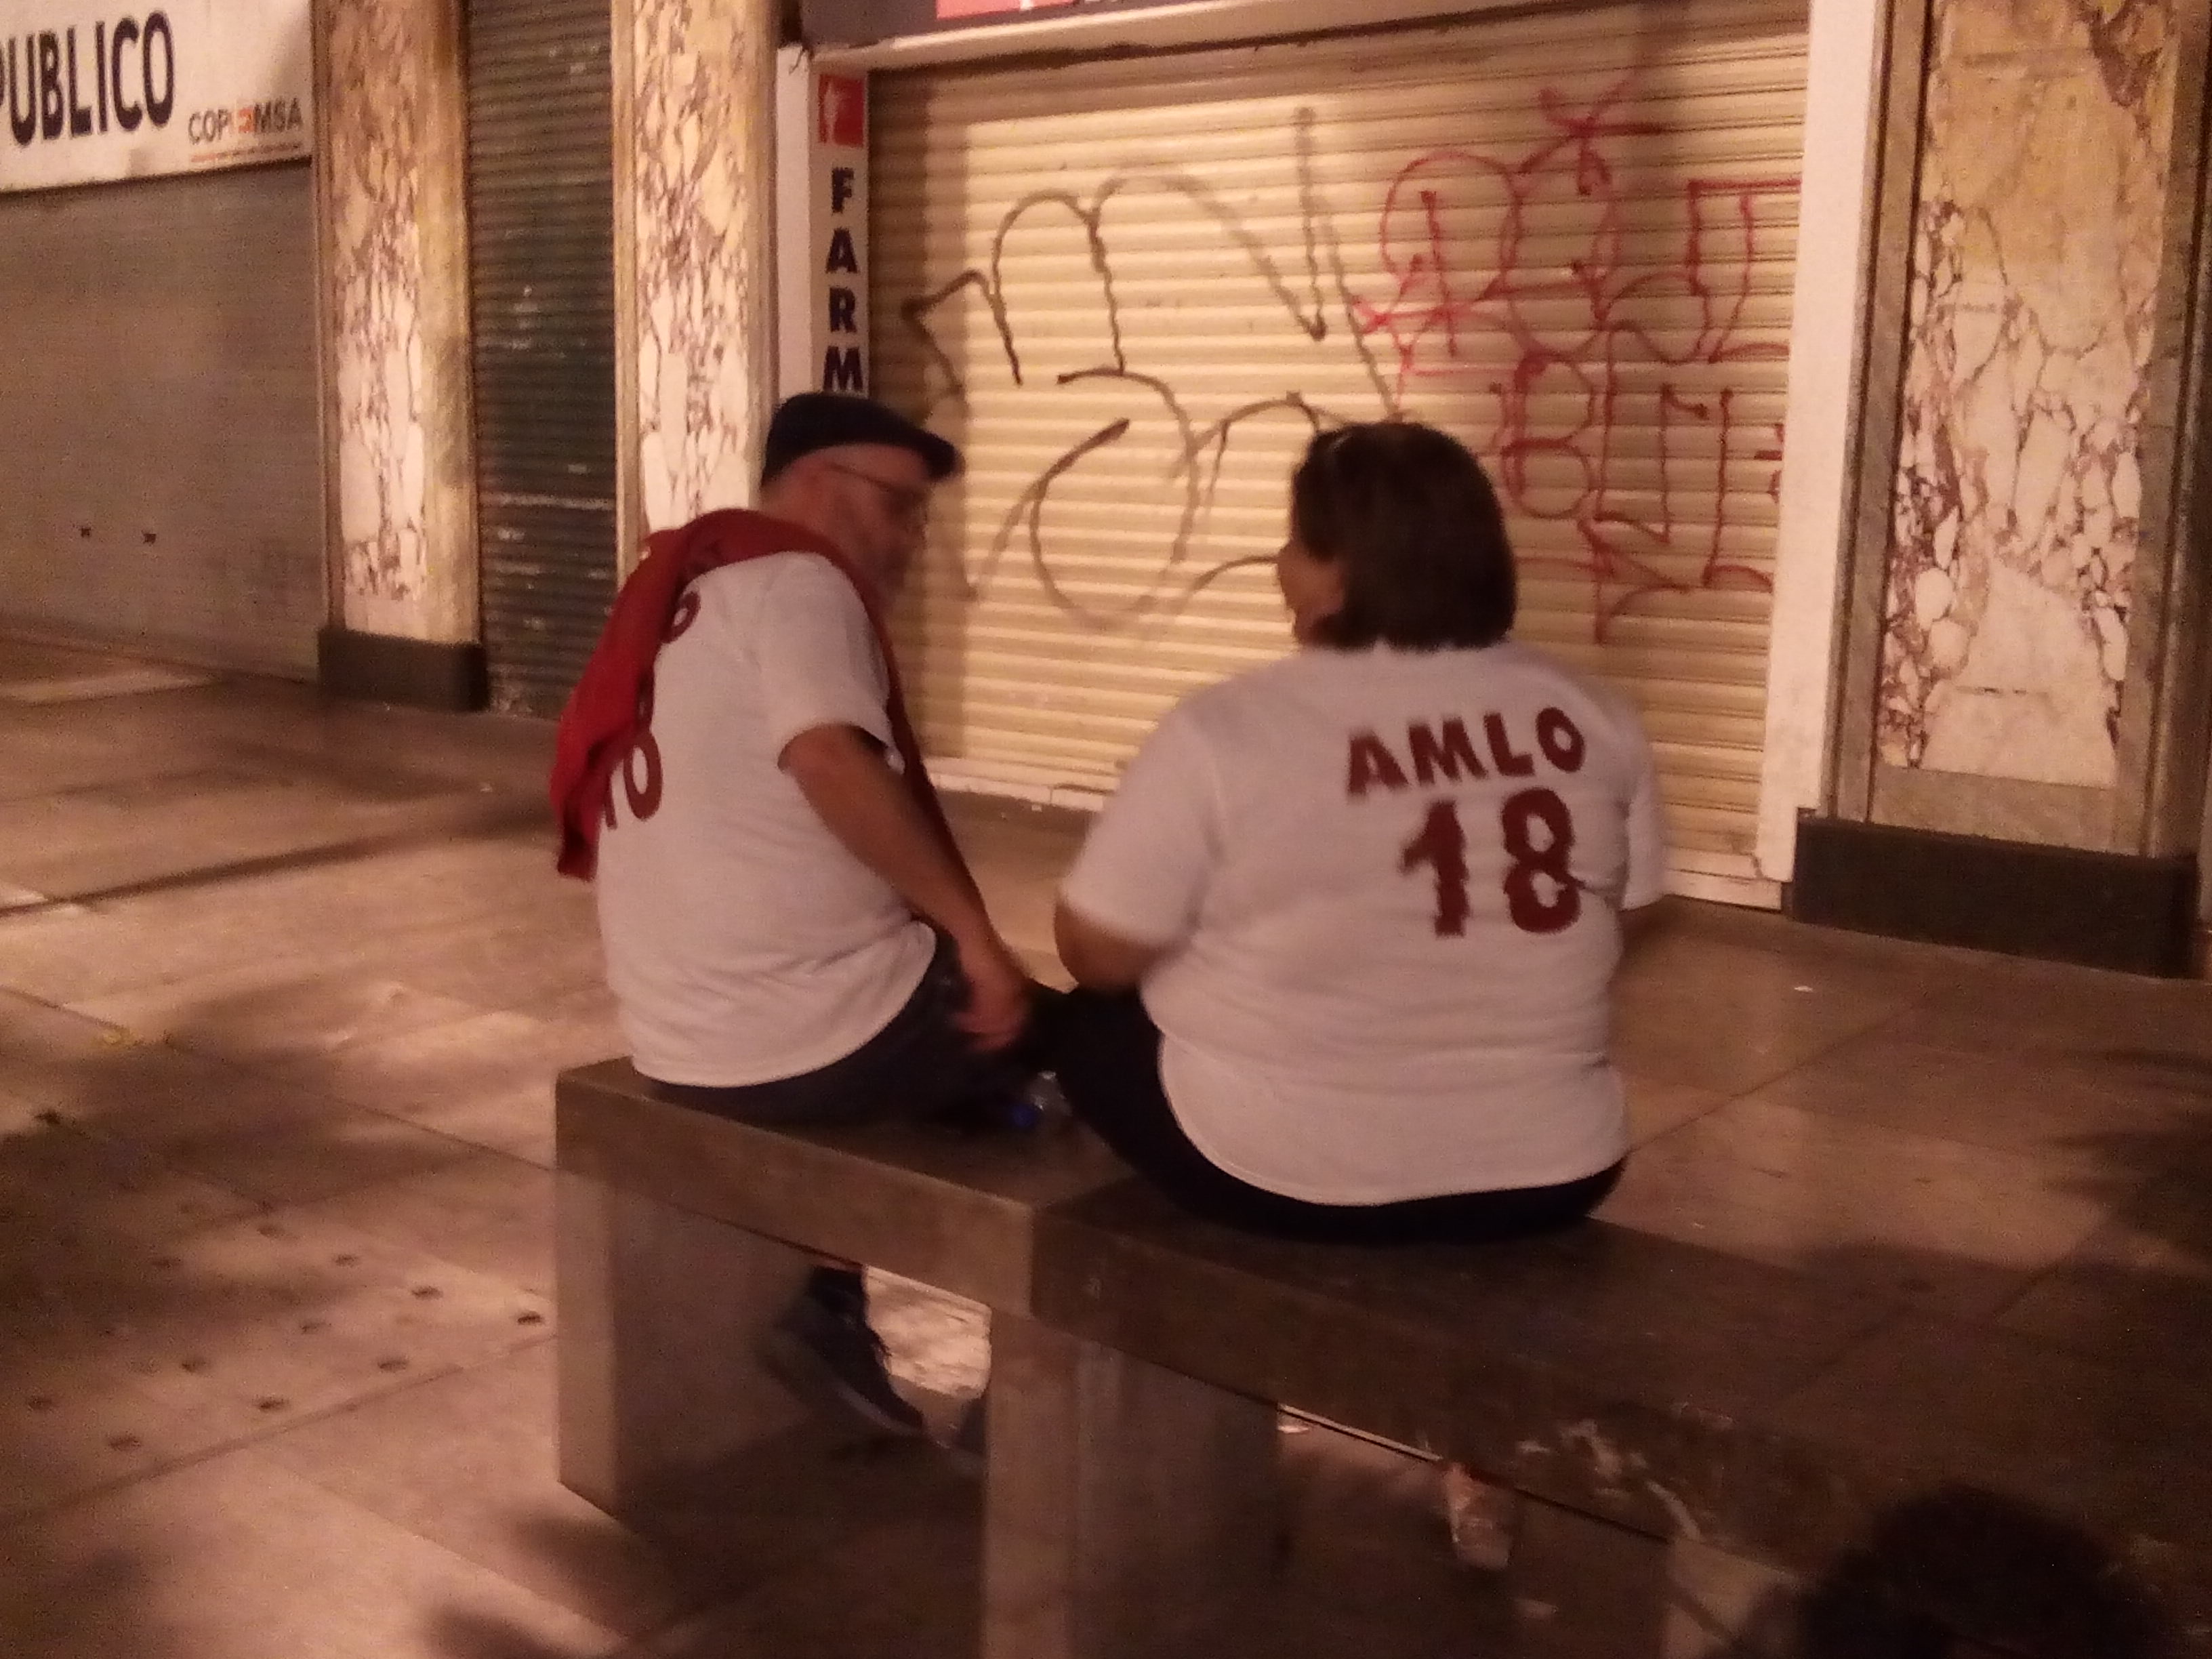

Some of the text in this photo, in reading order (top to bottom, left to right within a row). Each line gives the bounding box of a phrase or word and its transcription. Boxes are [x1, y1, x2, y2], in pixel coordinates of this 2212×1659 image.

[0, 9, 174, 147] UBLICO
[1347, 706, 1586, 802] AMLO
[1399, 787, 1584, 938] 18
